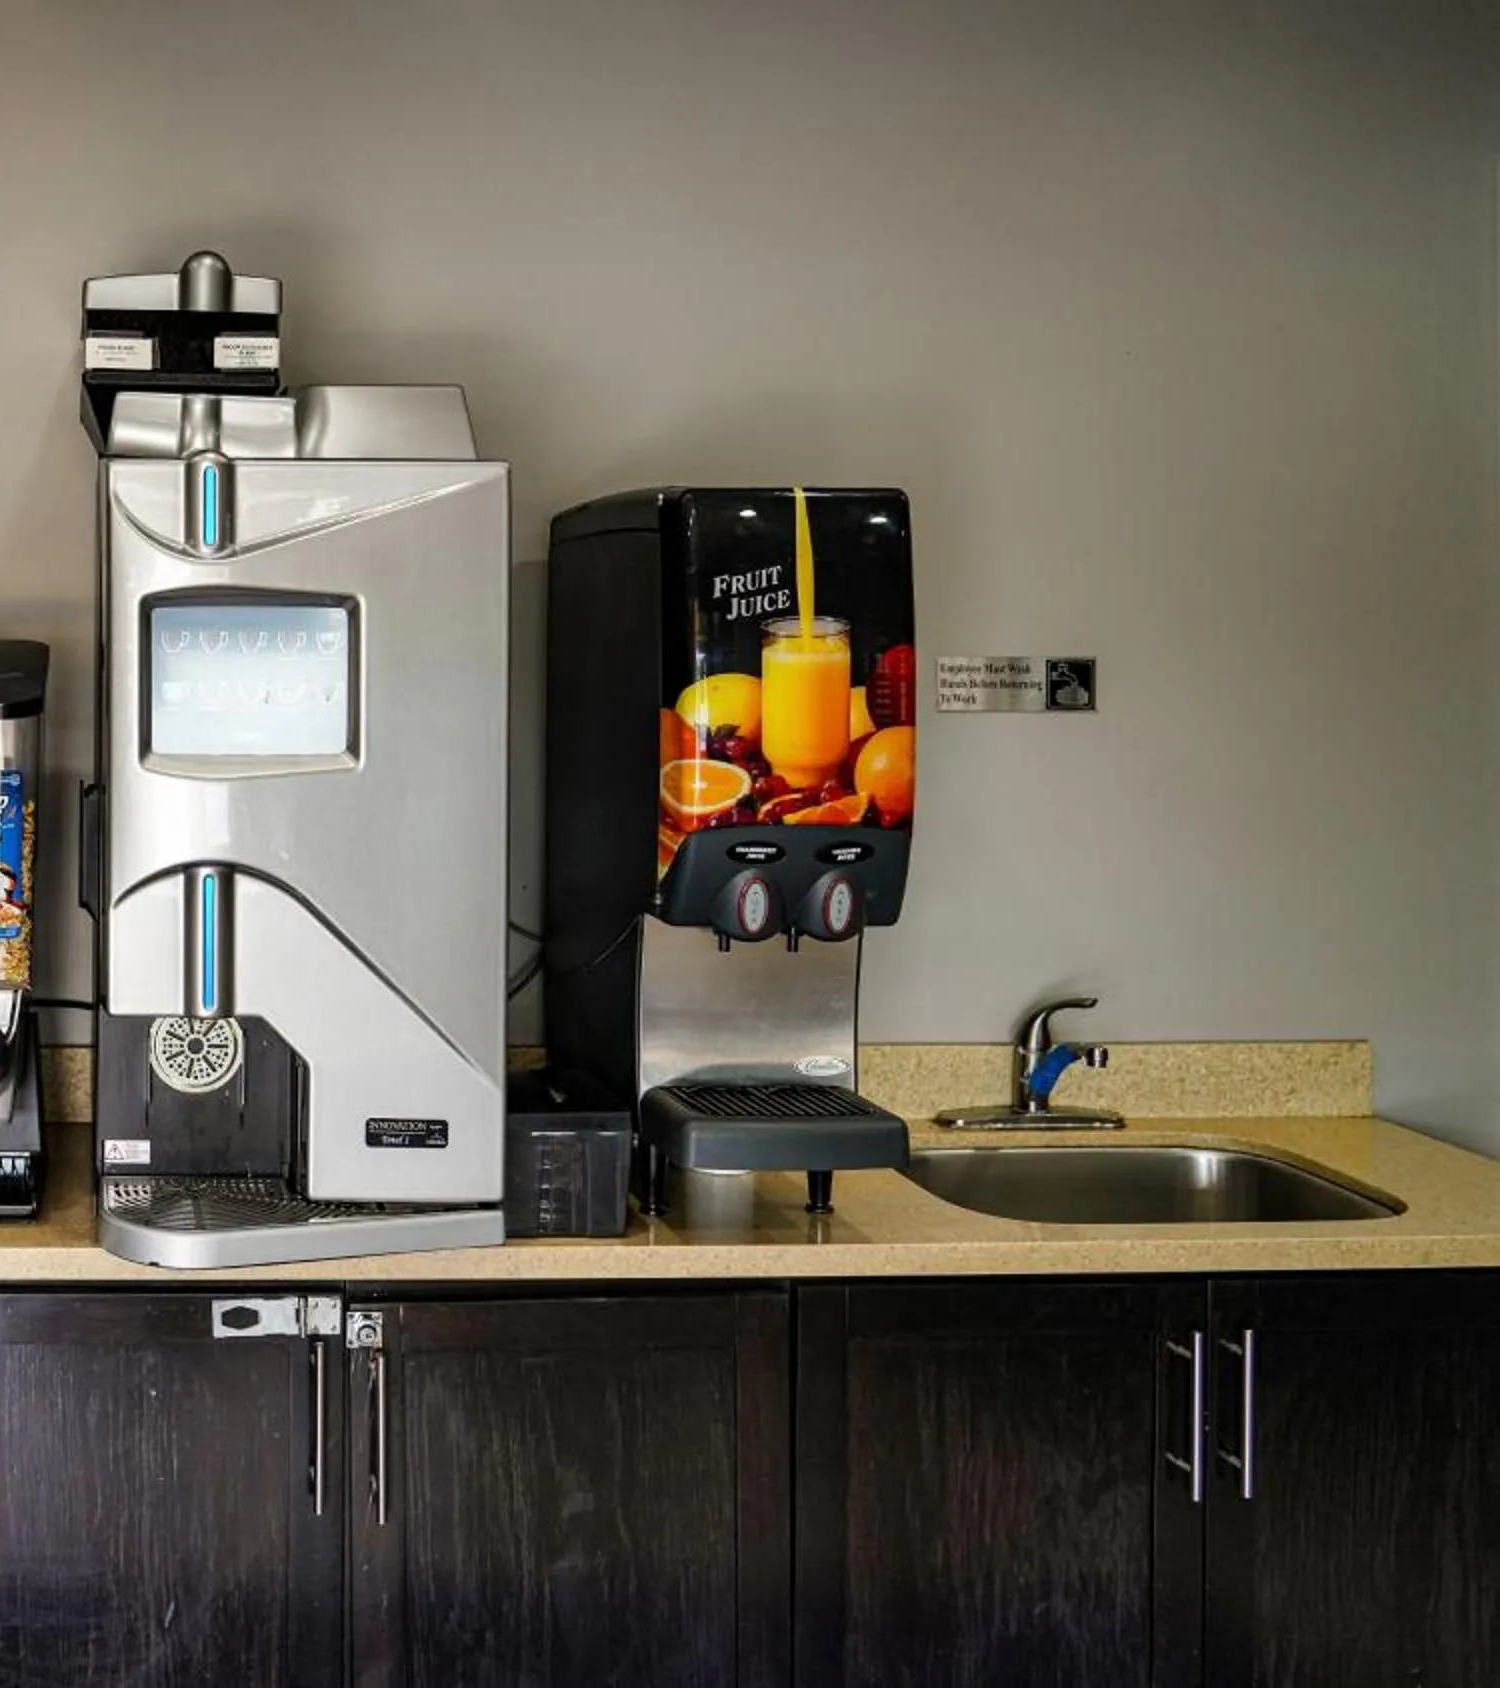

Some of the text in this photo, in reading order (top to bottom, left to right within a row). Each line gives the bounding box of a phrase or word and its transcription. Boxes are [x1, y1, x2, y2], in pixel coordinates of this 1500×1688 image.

[712, 565, 782, 599] FRUIT
[726, 589, 791, 621] JUICE
[984, 663, 1006, 674] Must
[1007, 663, 1031, 674] Wash
[952, 694, 977, 704] Work
